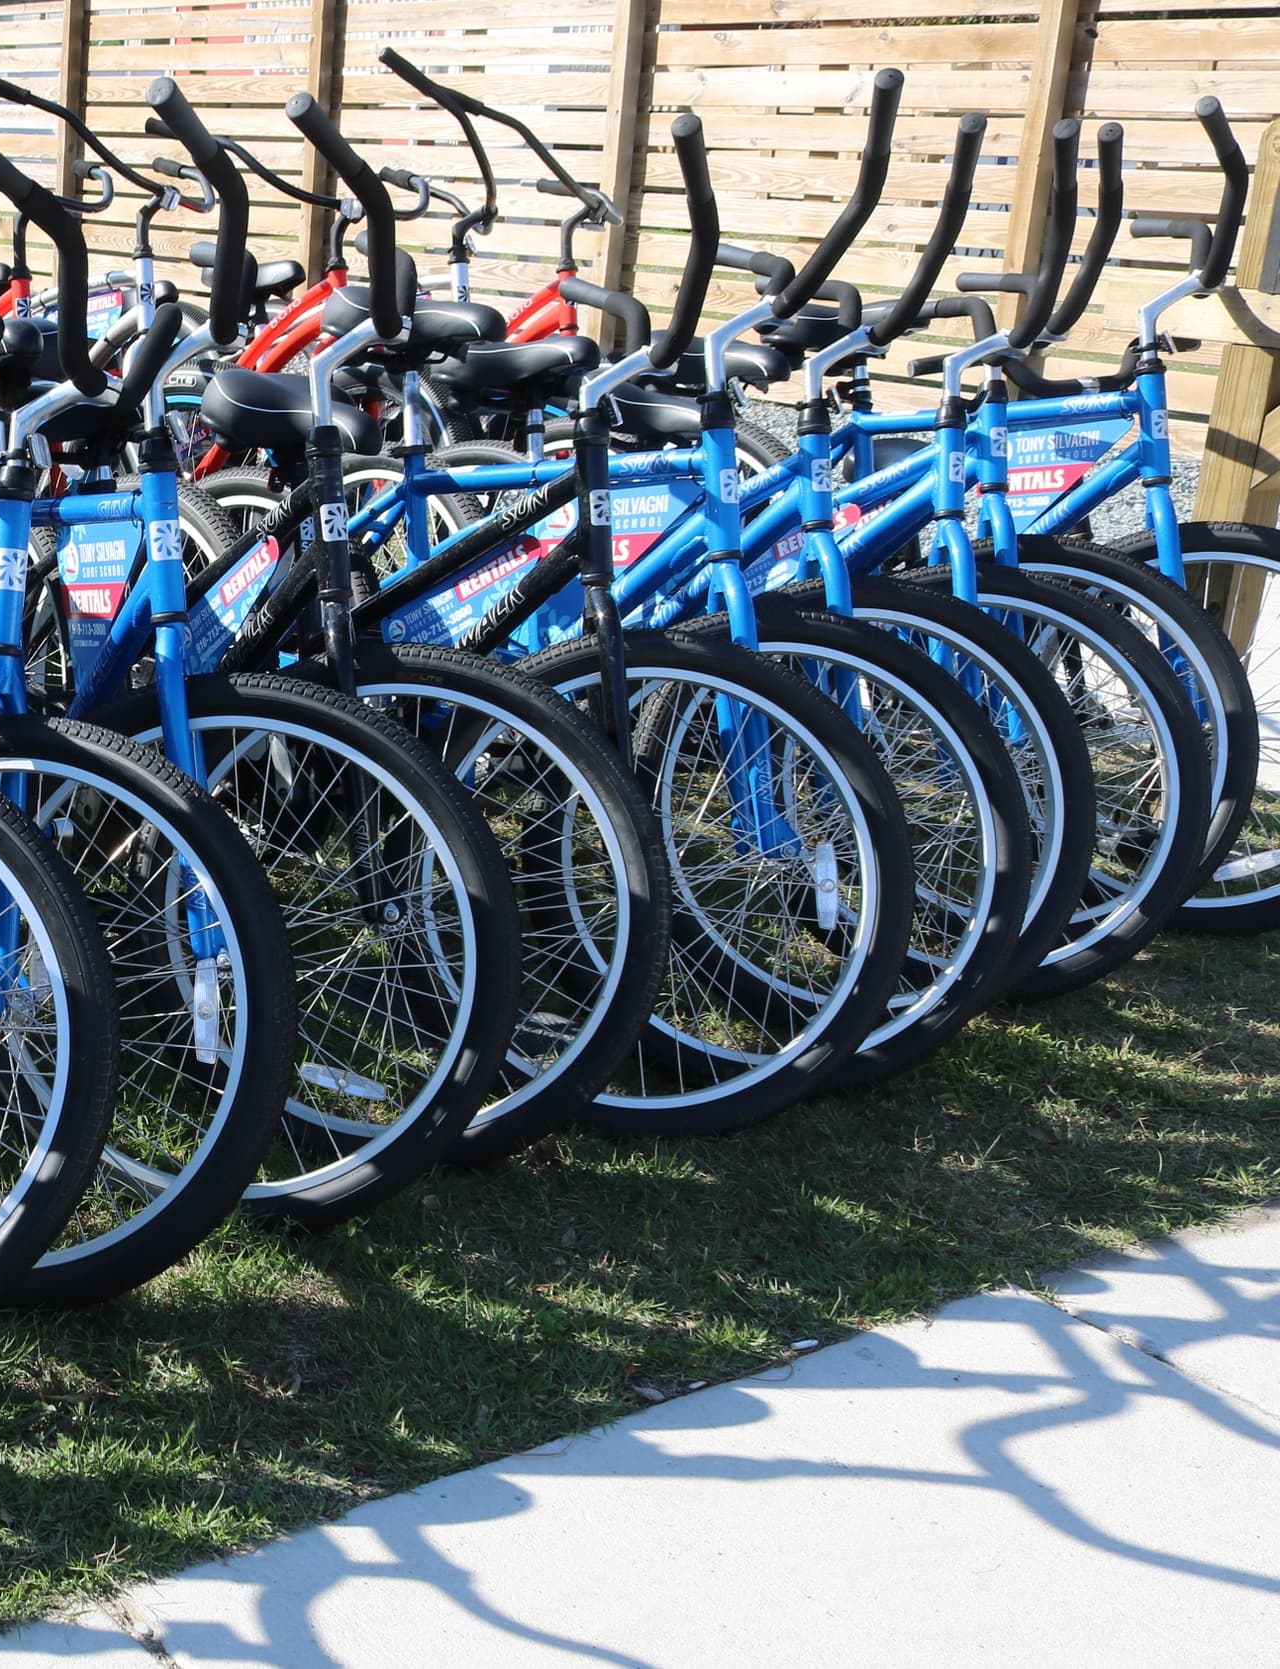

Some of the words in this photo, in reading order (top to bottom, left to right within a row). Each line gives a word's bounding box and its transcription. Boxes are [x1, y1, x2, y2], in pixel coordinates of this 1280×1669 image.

[88, 294, 118, 312] ENTALS
[1061, 393, 1117, 414] SUN
[1016, 436, 1046, 453] TONY
[1047, 430, 1101, 451] SILVAGNI
[621, 453, 670, 475] SUN
[1018, 453, 1050, 465] SURF
[859, 460, 910, 495] SUN
[1008, 469, 1065, 491] NTALS
[502, 483, 550, 531] SUN
[613, 494, 669, 517] SILVAGNI
[256, 494, 292, 541] SUN
[615, 517, 662, 530] SCHOOL
[78, 542, 96, 563] TONY
[221, 545, 271, 604] RENTALS
[457, 543, 529, 599] RENTALS
[69, 589, 112, 614] RENTALS
[404, 607, 422, 626] TONY
